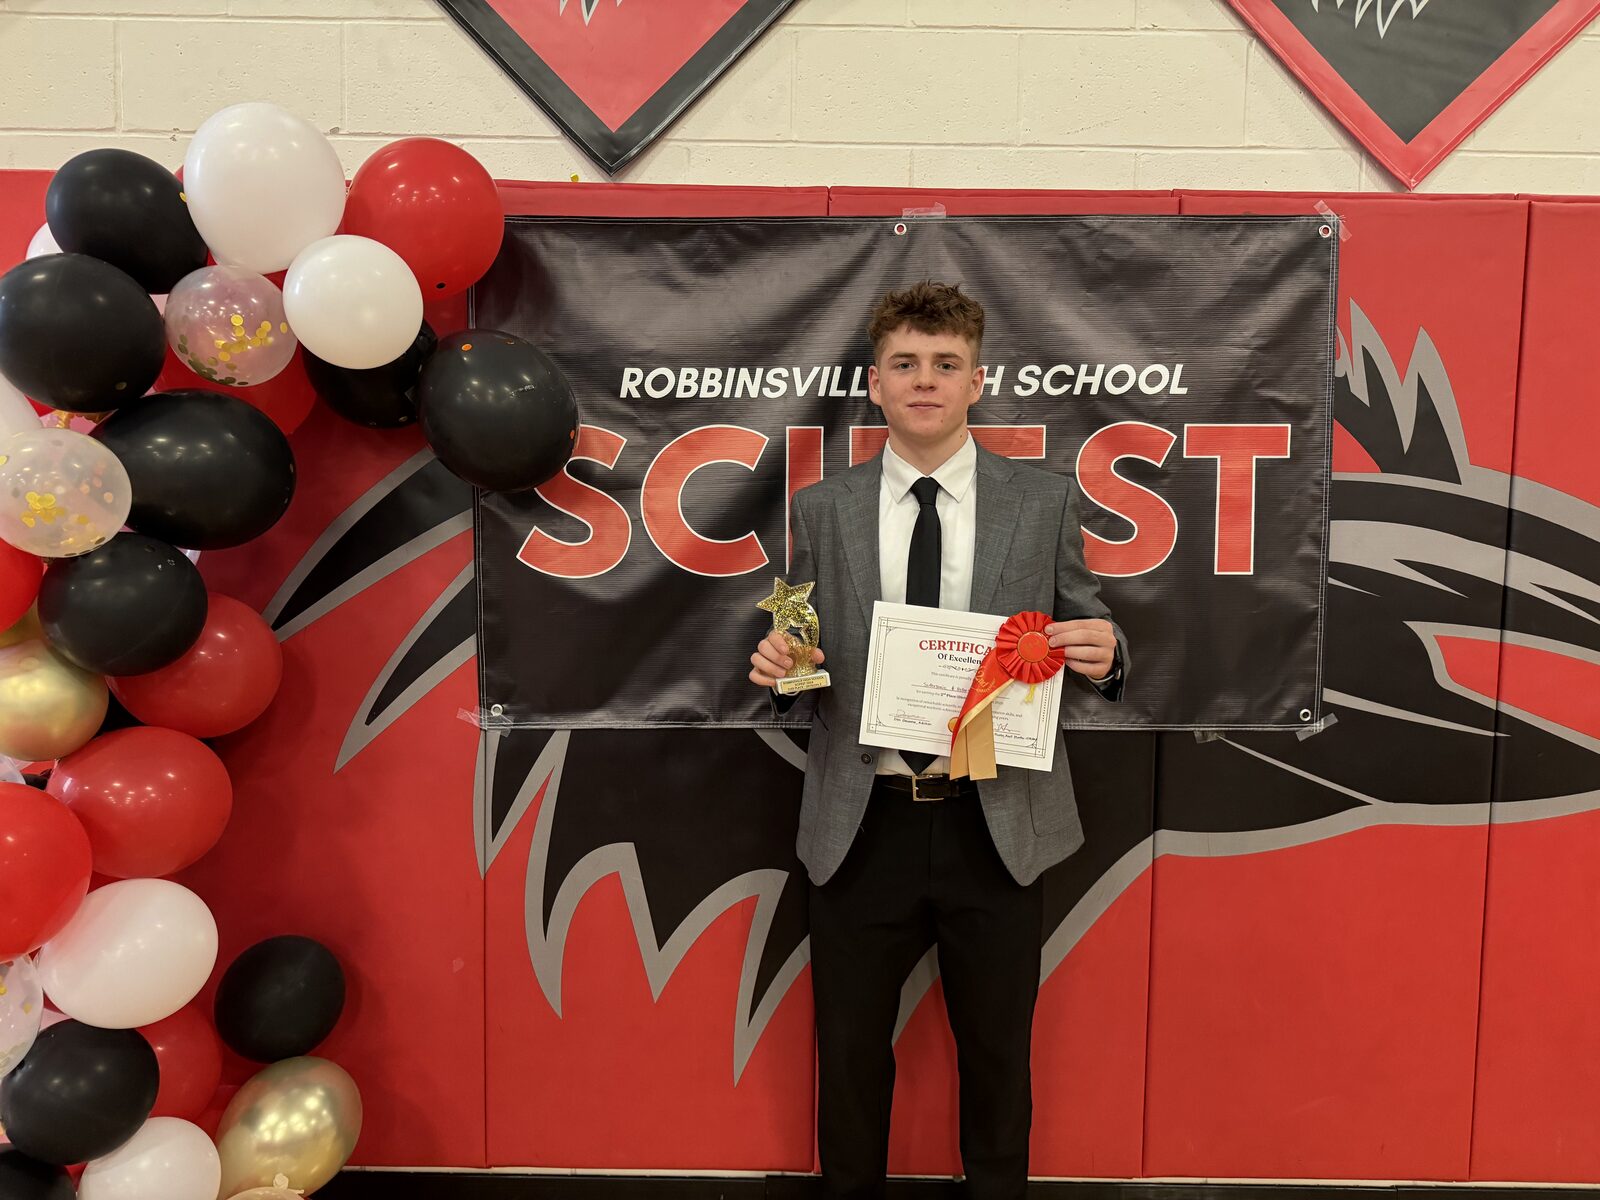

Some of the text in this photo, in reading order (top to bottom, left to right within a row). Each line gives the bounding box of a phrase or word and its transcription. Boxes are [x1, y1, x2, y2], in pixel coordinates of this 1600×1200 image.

[619, 366, 868, 399] ROBBINSVILL
[1013, 364, 1188, 397] SCHOOL
[515, 421, 1291, 579] SCIST
[918, 639, 992, 656] CERTIFICA
[937, 652, 982, 665] Of Excellen
